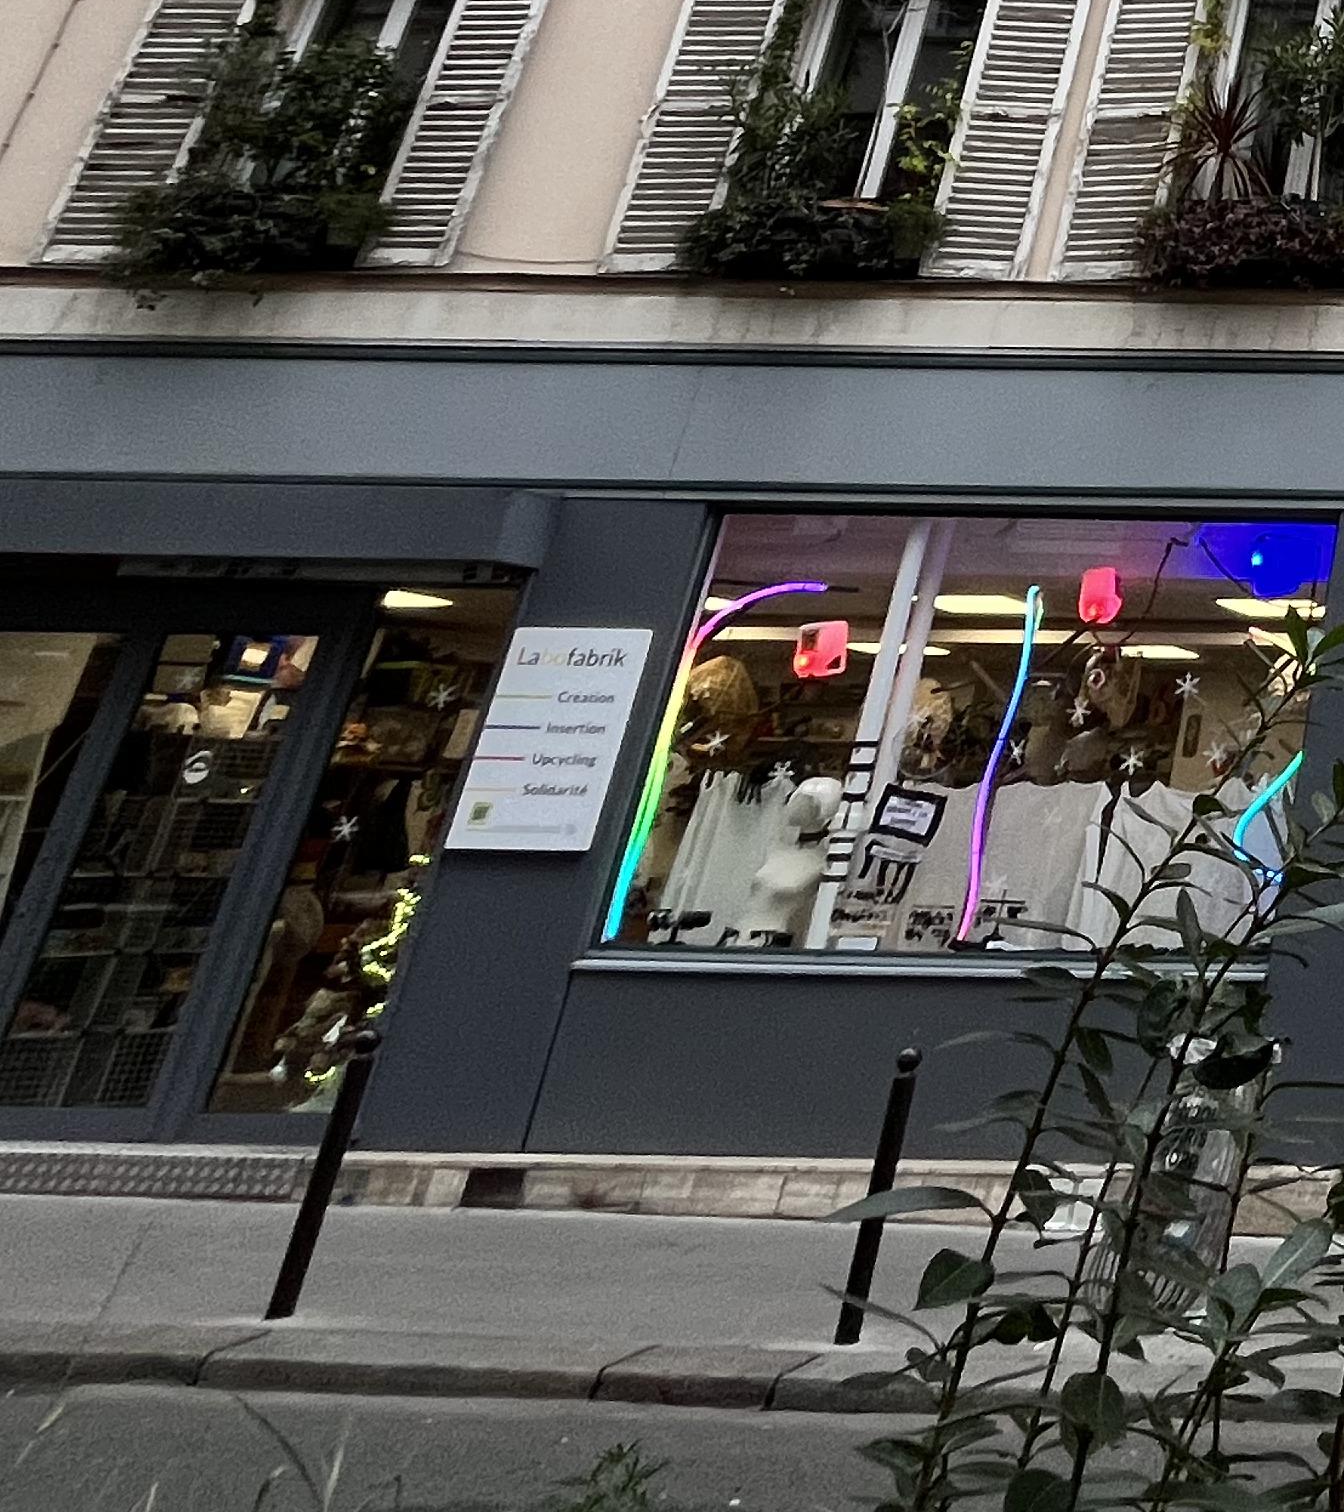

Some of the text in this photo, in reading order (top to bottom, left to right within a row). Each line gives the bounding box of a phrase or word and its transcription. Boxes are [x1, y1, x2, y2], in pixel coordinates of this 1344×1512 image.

[546, 721, 606, 734] Insertion
[532, 753, 597, 768] Upcycling
[521, 782, 588, 797] Solidarité
